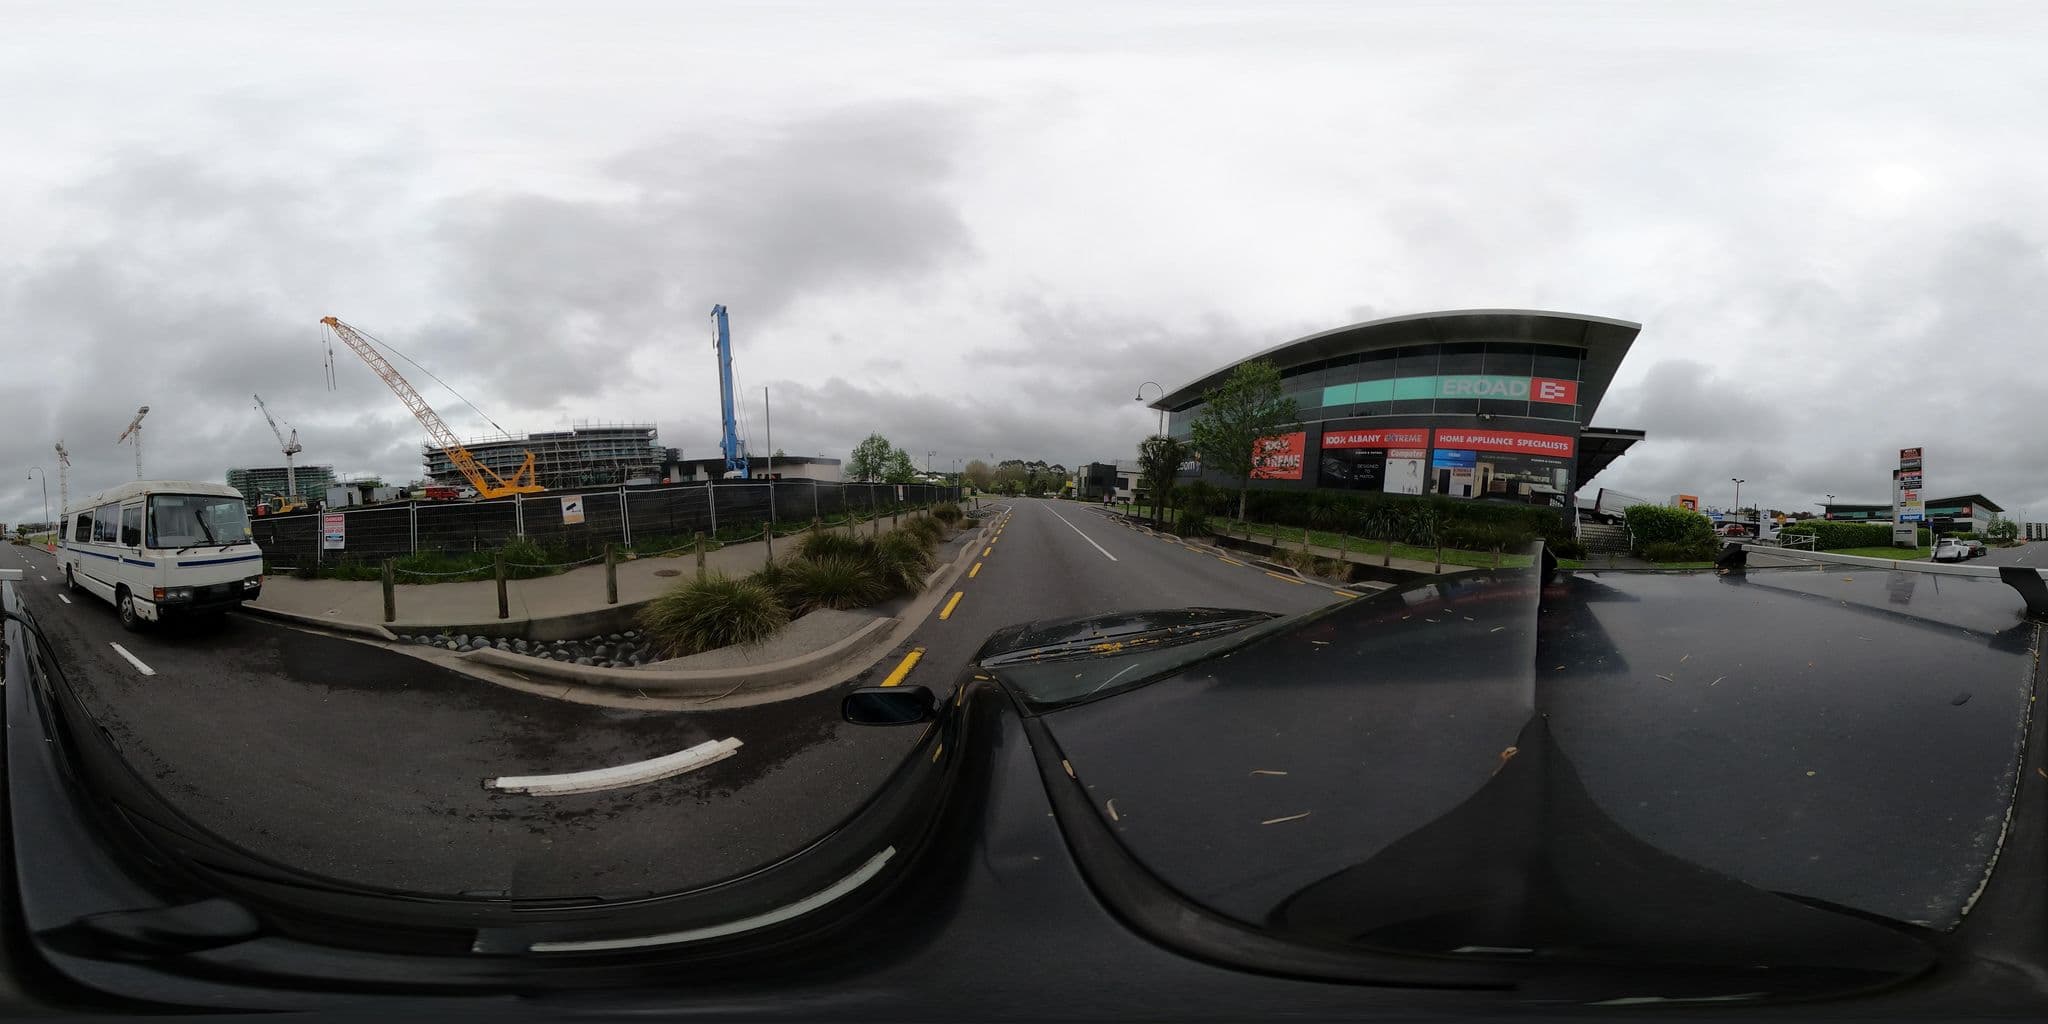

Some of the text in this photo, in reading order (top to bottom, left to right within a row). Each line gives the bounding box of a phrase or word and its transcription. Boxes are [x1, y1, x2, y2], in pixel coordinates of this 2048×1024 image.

[1443, 380, 1528, 396] EROAD
[1326, 434, 1423, 445] 100% ALBANY EXTREME
[1439, 434, 1569, 451] HOME APPLIANCE SPECIALISTS
[1253, 455, 1301, 468] ETREME
